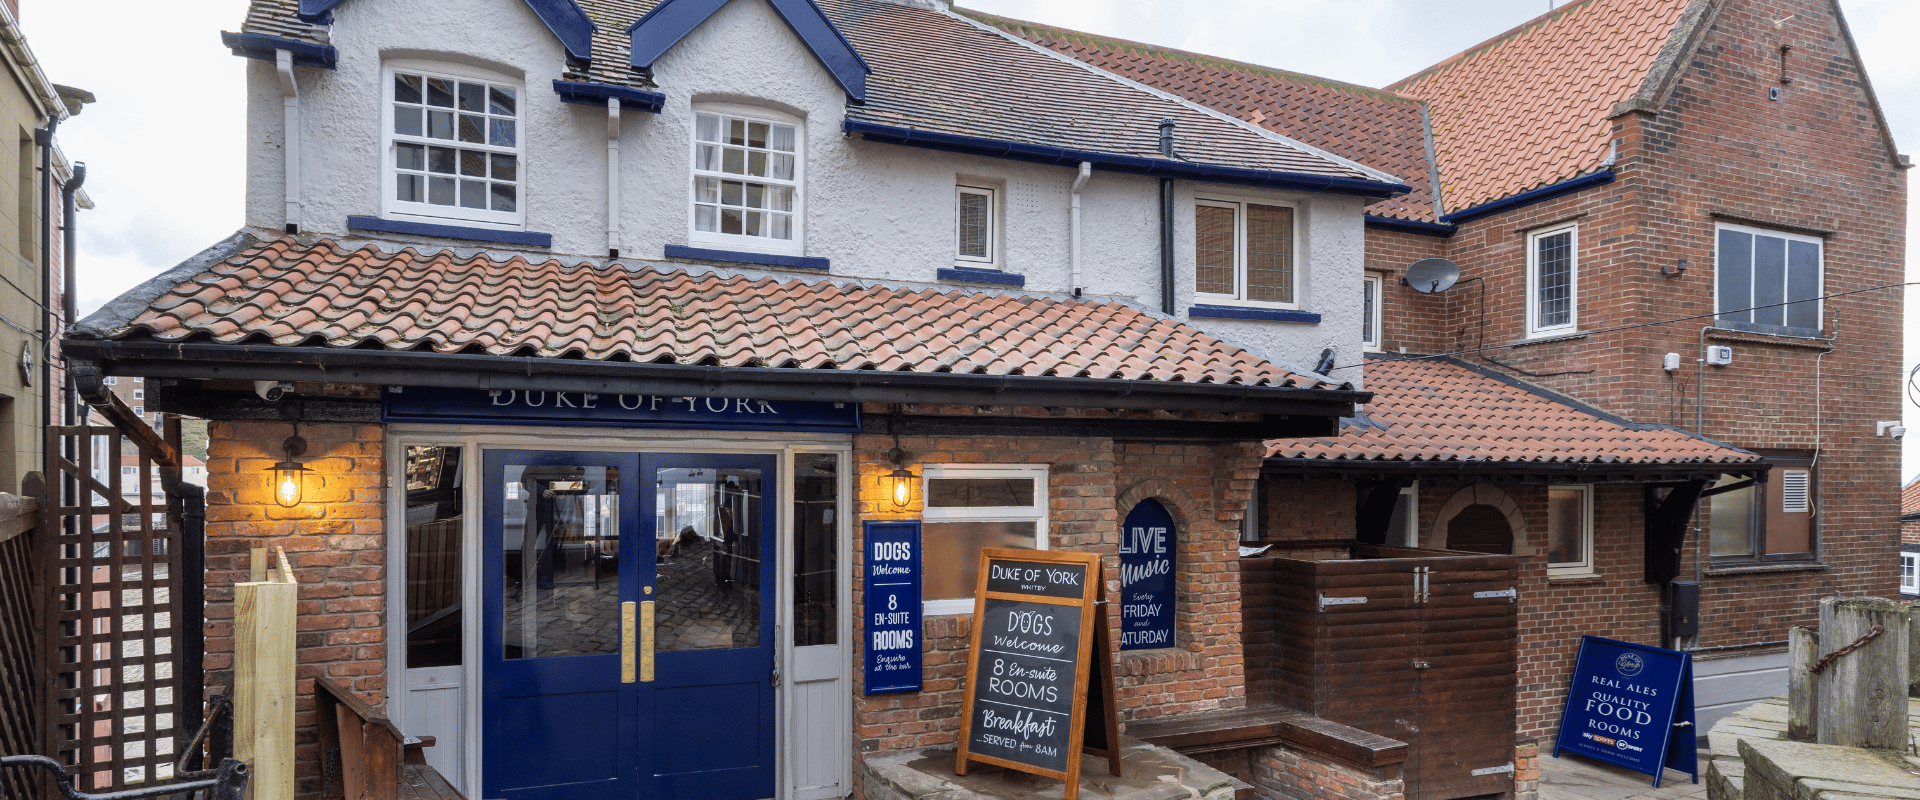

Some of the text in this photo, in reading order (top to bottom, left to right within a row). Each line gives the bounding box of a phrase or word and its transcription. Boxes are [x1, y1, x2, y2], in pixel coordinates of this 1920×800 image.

[491, 389, 779, 414] DUKE OF YORK
[1119, 527, 1166, 553] LIVE
[875, 542, 910, 560] DOGS
[873, 564, 911, 576] Welcome
[992, 565, 1079, 585] DUKE OF YORK
[1120, 555, 1169, 587] Music
[888, 595, 897, 610] 8
[1133, 593, 1154, 603] Every
[875, 612, 909, 625] EN-SUITE
[1124, 604, 1162, 618] FRIDAY
[1008, 611, 1053, 635] DOGS
[1134, 619, 1150, 627] and
[874, 630, 913, 650] ROOMS
[995, 636, 1064, 653] Welcome
[1121, 629, 1169, 645] ATURDAY
[899, 662, 911, 670] bar
[993, 659, 1057, 681] 8 En-suite
[989, 677, 1058, 702] ROOMS
[1592, 676, 1657, 696] REAL ALES
[1593, 692, 1650, 710] QUALITY
[1585, 699, 1651, 725] FOOD
[983, 709, 1057, 740] Breakfast
[1588, 719, 1640, 739] ROOMS
[1594, 735, 1614, 745] sports
[1035, 744, 1057, 757] 8AM
